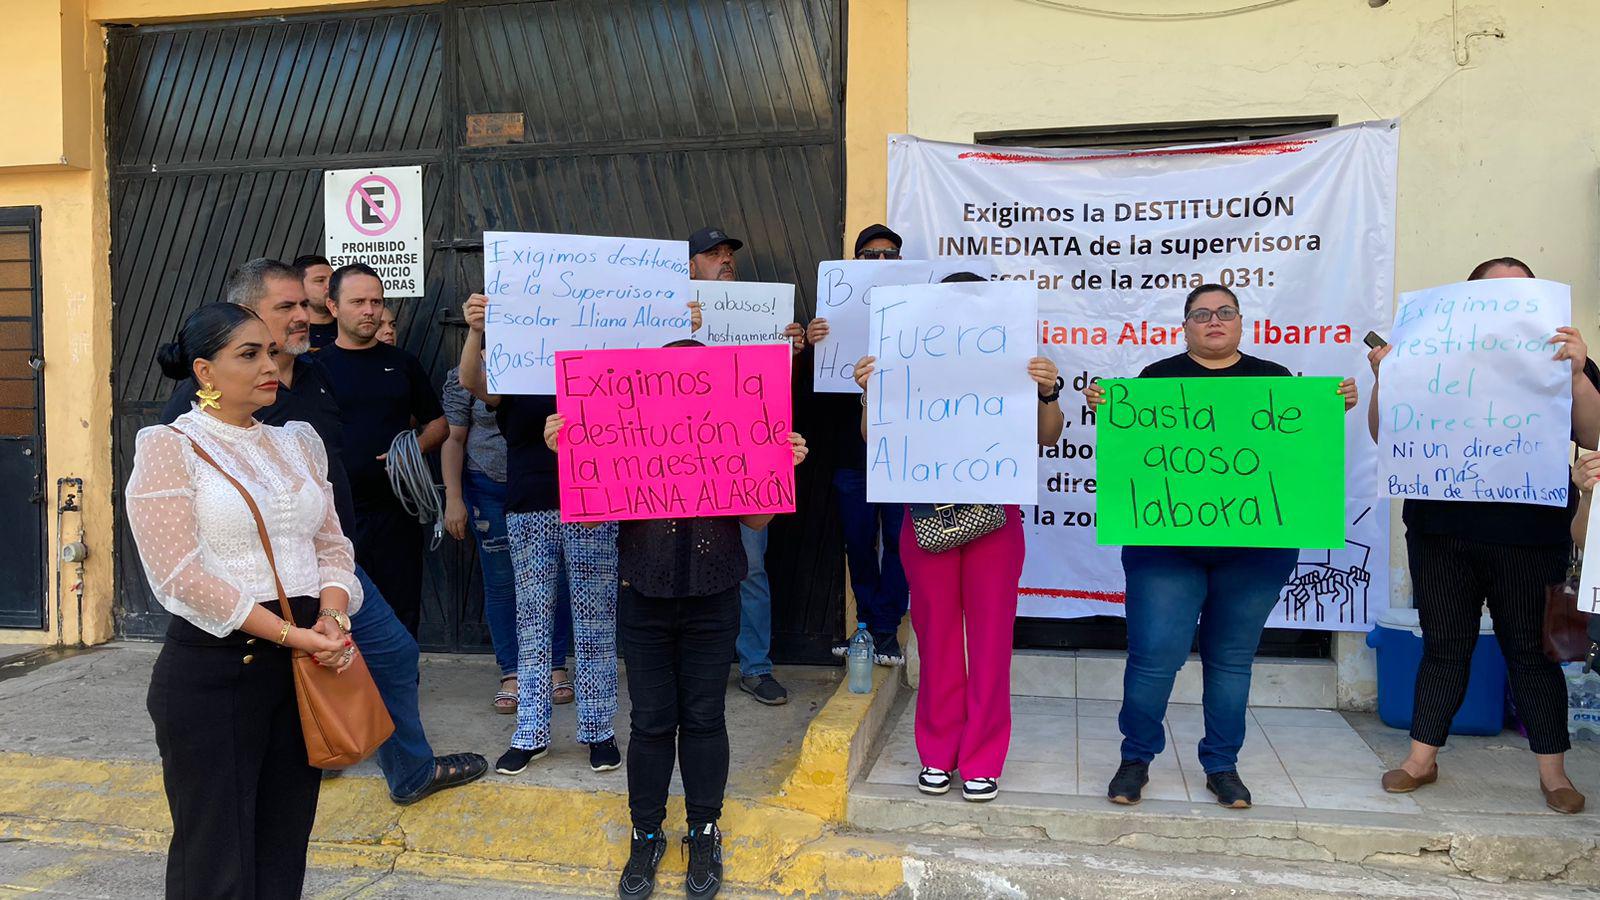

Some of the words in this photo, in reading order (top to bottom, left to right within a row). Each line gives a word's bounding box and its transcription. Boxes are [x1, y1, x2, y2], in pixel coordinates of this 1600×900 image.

[963, 202, 1074, 228] Exigimos
[1083, 202, 1104, 222] la
[1115, 191, 1294, 222] DESTITUCIÓN
[330, 253, 418, 266] ESTACIONARSE
[342, 241, 405, 253] PROHIBIDO
[489, 240, 596, 278] Exigimos
[608, 244, 689, 275] destitución
[938, 236, 1081, 256] INMEDIATA
[1090, 234, 1121, 256] de
[1130, 235, 1152, 255] la
[1160, 232, 1321, 260] supervisora
[384, 279, 415, 290] ORAS
[487, 270, 510, 295] de
[524, 275, 541, 295] la
[553, 271, 675, 307] Supervisora
[1070, 268, 1101, 290] de
[1111, 268, 1132, 290] la
[1141, 273, 1204, 290] zona
[1220, 267, 1275, 288] 031:
[487, 304, 560, 326] Escolar
[571, 303, 627, 328] Iliana
[633, 305, 692, 328] Alarcón
[714, 291, 776, 315] abusos!
[1399, 297, 1538, 332] Exigimos
[875, 301, 1006, 359] Fuera
[1253, 319, 1352, 344] Ibarra
[562, 356, 711, 410] Exigimos
[734, 353, 764, 400] la
[872, 365, 1003, 426] Iliana
[1428, 363, 1475, 397] del
[567, 400, 740, 447] destitución
[750, 402, 790, 446] de
[1109, 383, 1216, 432] Basta
[1251, 388, 1303, 433] de
[1391, 401, 1541, 433] Director
[872, 435, 1018, 482] Alarcón
[1143, 444, 1260, 476] acoso
[1392, 441, 1415, 458] Ni
[1423, 443, 1448, 458] un
[1463, 432, 1543, 458] director
[570, 448, 601, 483] la
[613, 444, 747, 481] maestra
[1435, 461, 1479, 483] más
[569, 483, 687, 517] ILIANA
[696, 471, 793, 512] ALARCÓN
[1130, 471, 1283, 528] laboral
[1388, 474, 1429, 496] Basta
[1443, 483, 1464, 499] de
[1473, 472, 1567, 502] favoritismo
[1034, 505, 1055, 526] la
